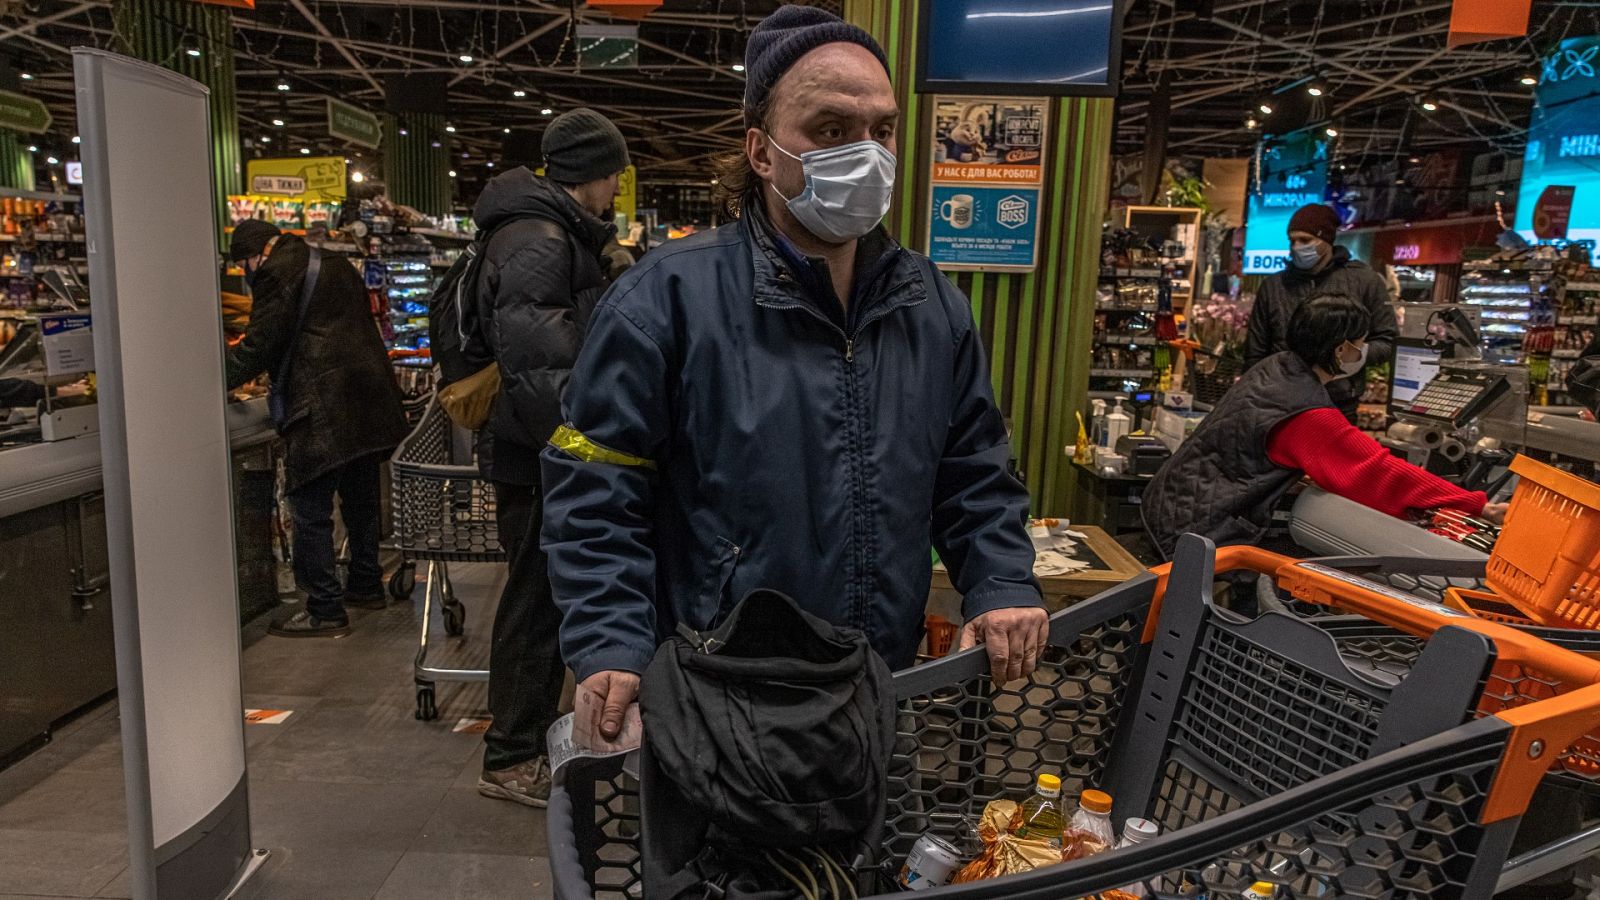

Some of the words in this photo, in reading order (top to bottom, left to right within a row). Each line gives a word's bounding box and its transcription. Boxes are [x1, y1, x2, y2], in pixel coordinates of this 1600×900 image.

[937, 167, 943, 177] У
[944, 167, 960, 177] НАС
[961, 168, 967, 177] Є
[967, 168, 985, 178] ДЛЯ
[986, 168, 1003, 178] ВАС
[1003, 168, 1037, 179] РОБОТА!
[1001, 209, 1025, 223] BOSS
[1253, 255, 1286, 269] BOR
